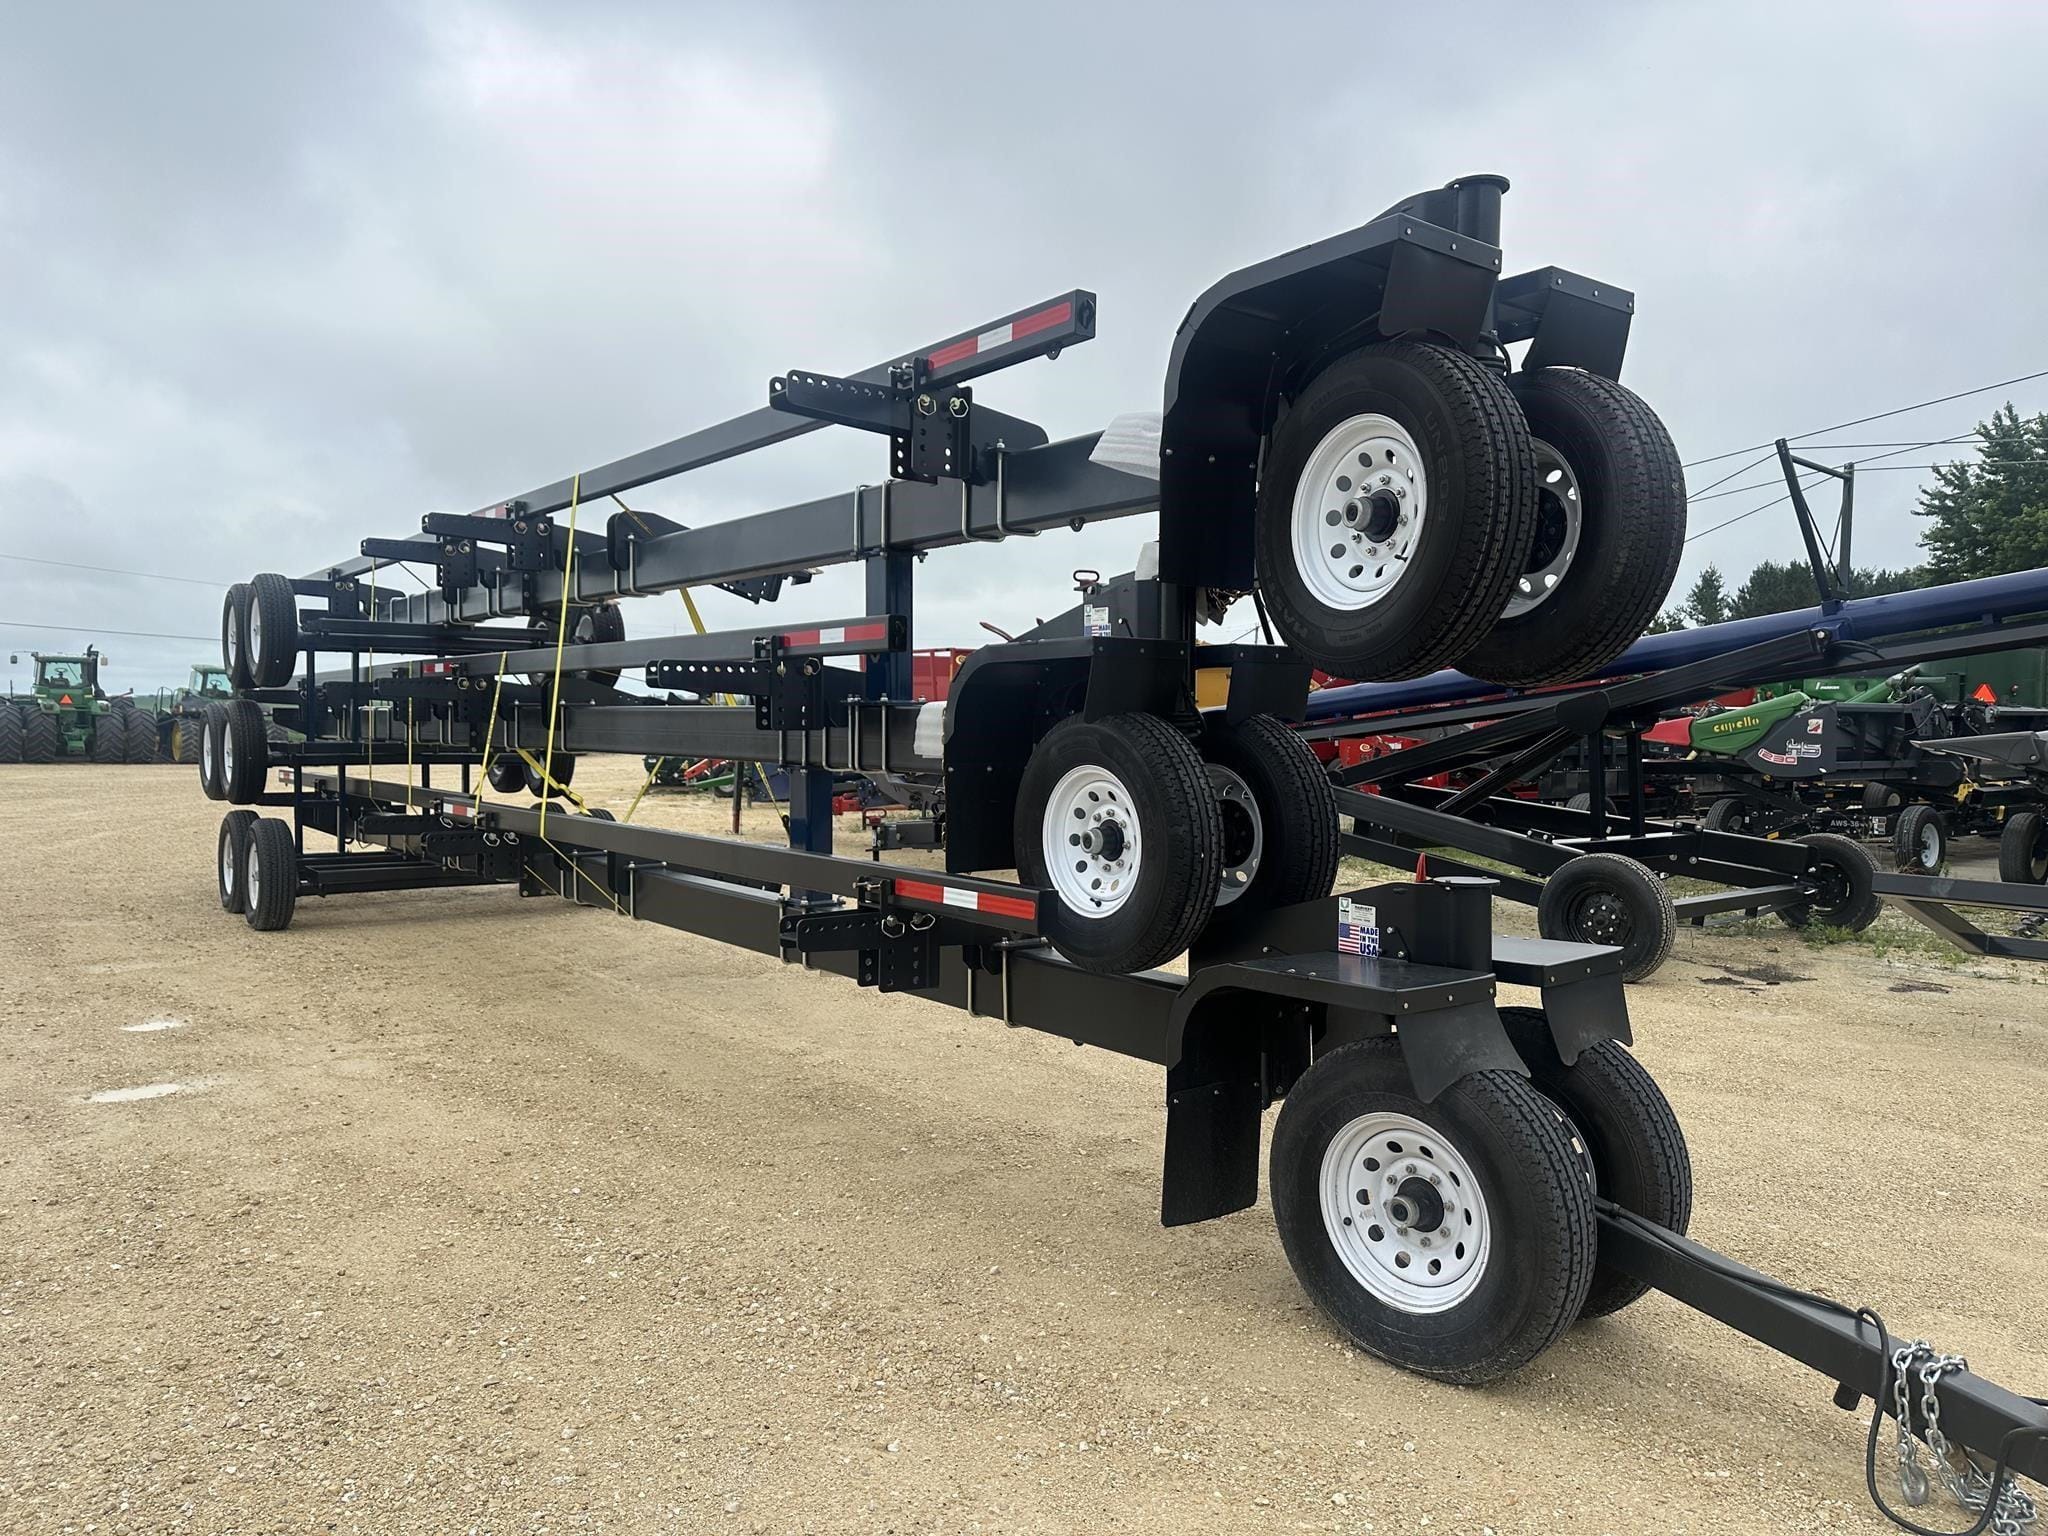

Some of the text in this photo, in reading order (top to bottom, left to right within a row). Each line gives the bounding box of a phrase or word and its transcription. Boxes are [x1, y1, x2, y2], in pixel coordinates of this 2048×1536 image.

[1758, 748, 1798, 765] 1230
[1830, 819, 1860, 827] AWS-36
[1360, 926, 1378, 936] MADE
[1360, 935, 1367, 943] IN
[1360, 943, 1378, 957] USA
